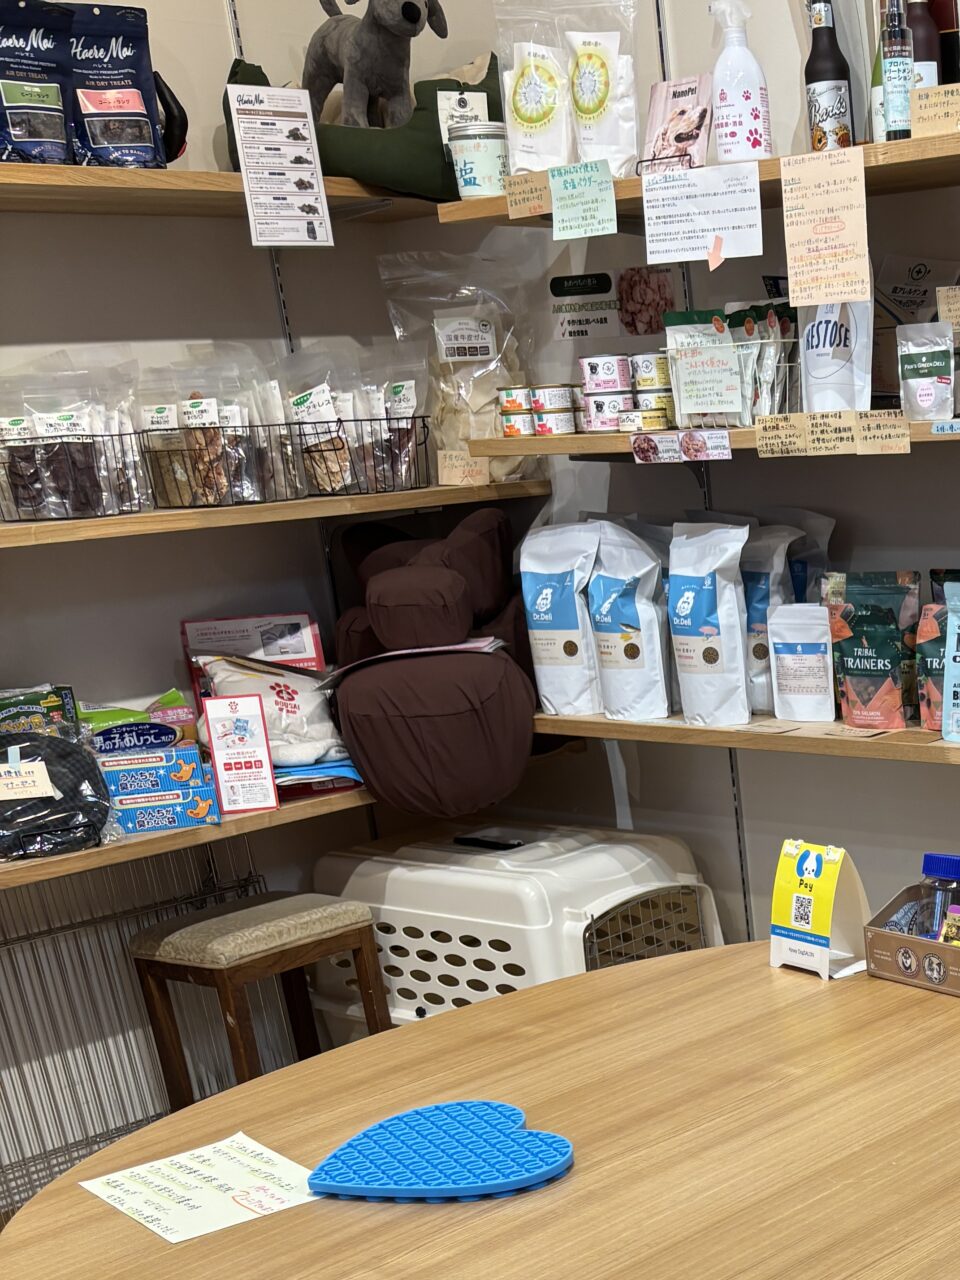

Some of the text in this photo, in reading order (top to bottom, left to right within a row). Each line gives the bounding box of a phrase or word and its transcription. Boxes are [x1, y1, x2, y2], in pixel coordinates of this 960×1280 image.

[0, 25, 55, 51] aere Mai
[70, 35, 134, 62] Haere Mai
[917, 360, 932, 369] GREEN
[933, 359, 945, 367] DELI
[532, 612, 553, 621] Dr.Deli
[673, 617, 691, 626] Dr.Deli
[854, 648, 877, 658] TRIBAL
[844, 657, 892, 671] TRAINERS
[120, 770, 156, 782] うんちが
[119, 779, 161, 792] 臭わない袋
[137, 808, 173, 820] うんちが
[136, 816, 177, 830] 臭わない袋
[798, 878, 814, 893] Pay
